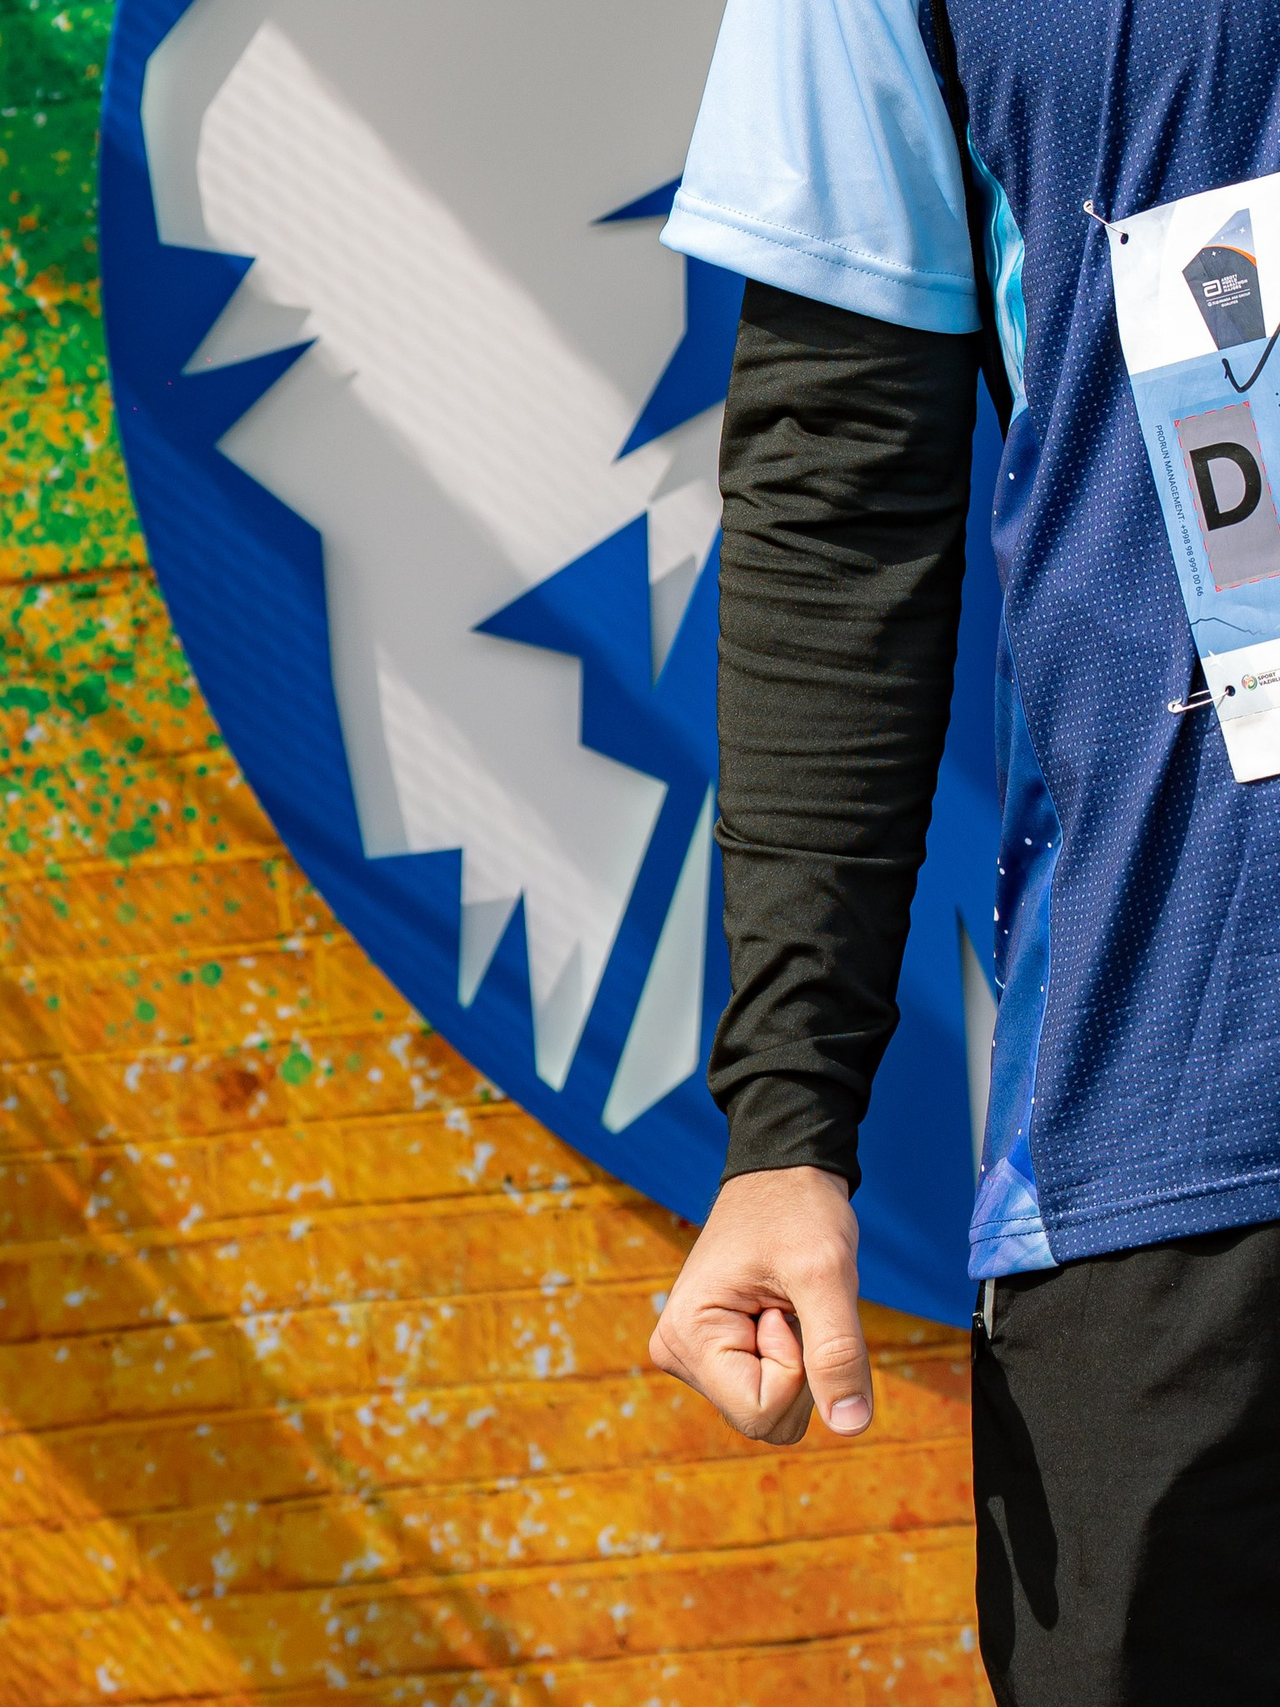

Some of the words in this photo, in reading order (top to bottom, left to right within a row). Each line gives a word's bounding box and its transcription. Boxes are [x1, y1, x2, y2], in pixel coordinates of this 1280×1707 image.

[1156, 425, 1170, 459] PRORUN
[1164, 461, 1186, 524] MANAGEMENT:
[1189, 442, 1262, 531] D
[1181, 525, 1190, 544] +998
[1185, 545, 1193, 556] 98
[1188, 558, 1199, 573] 999
